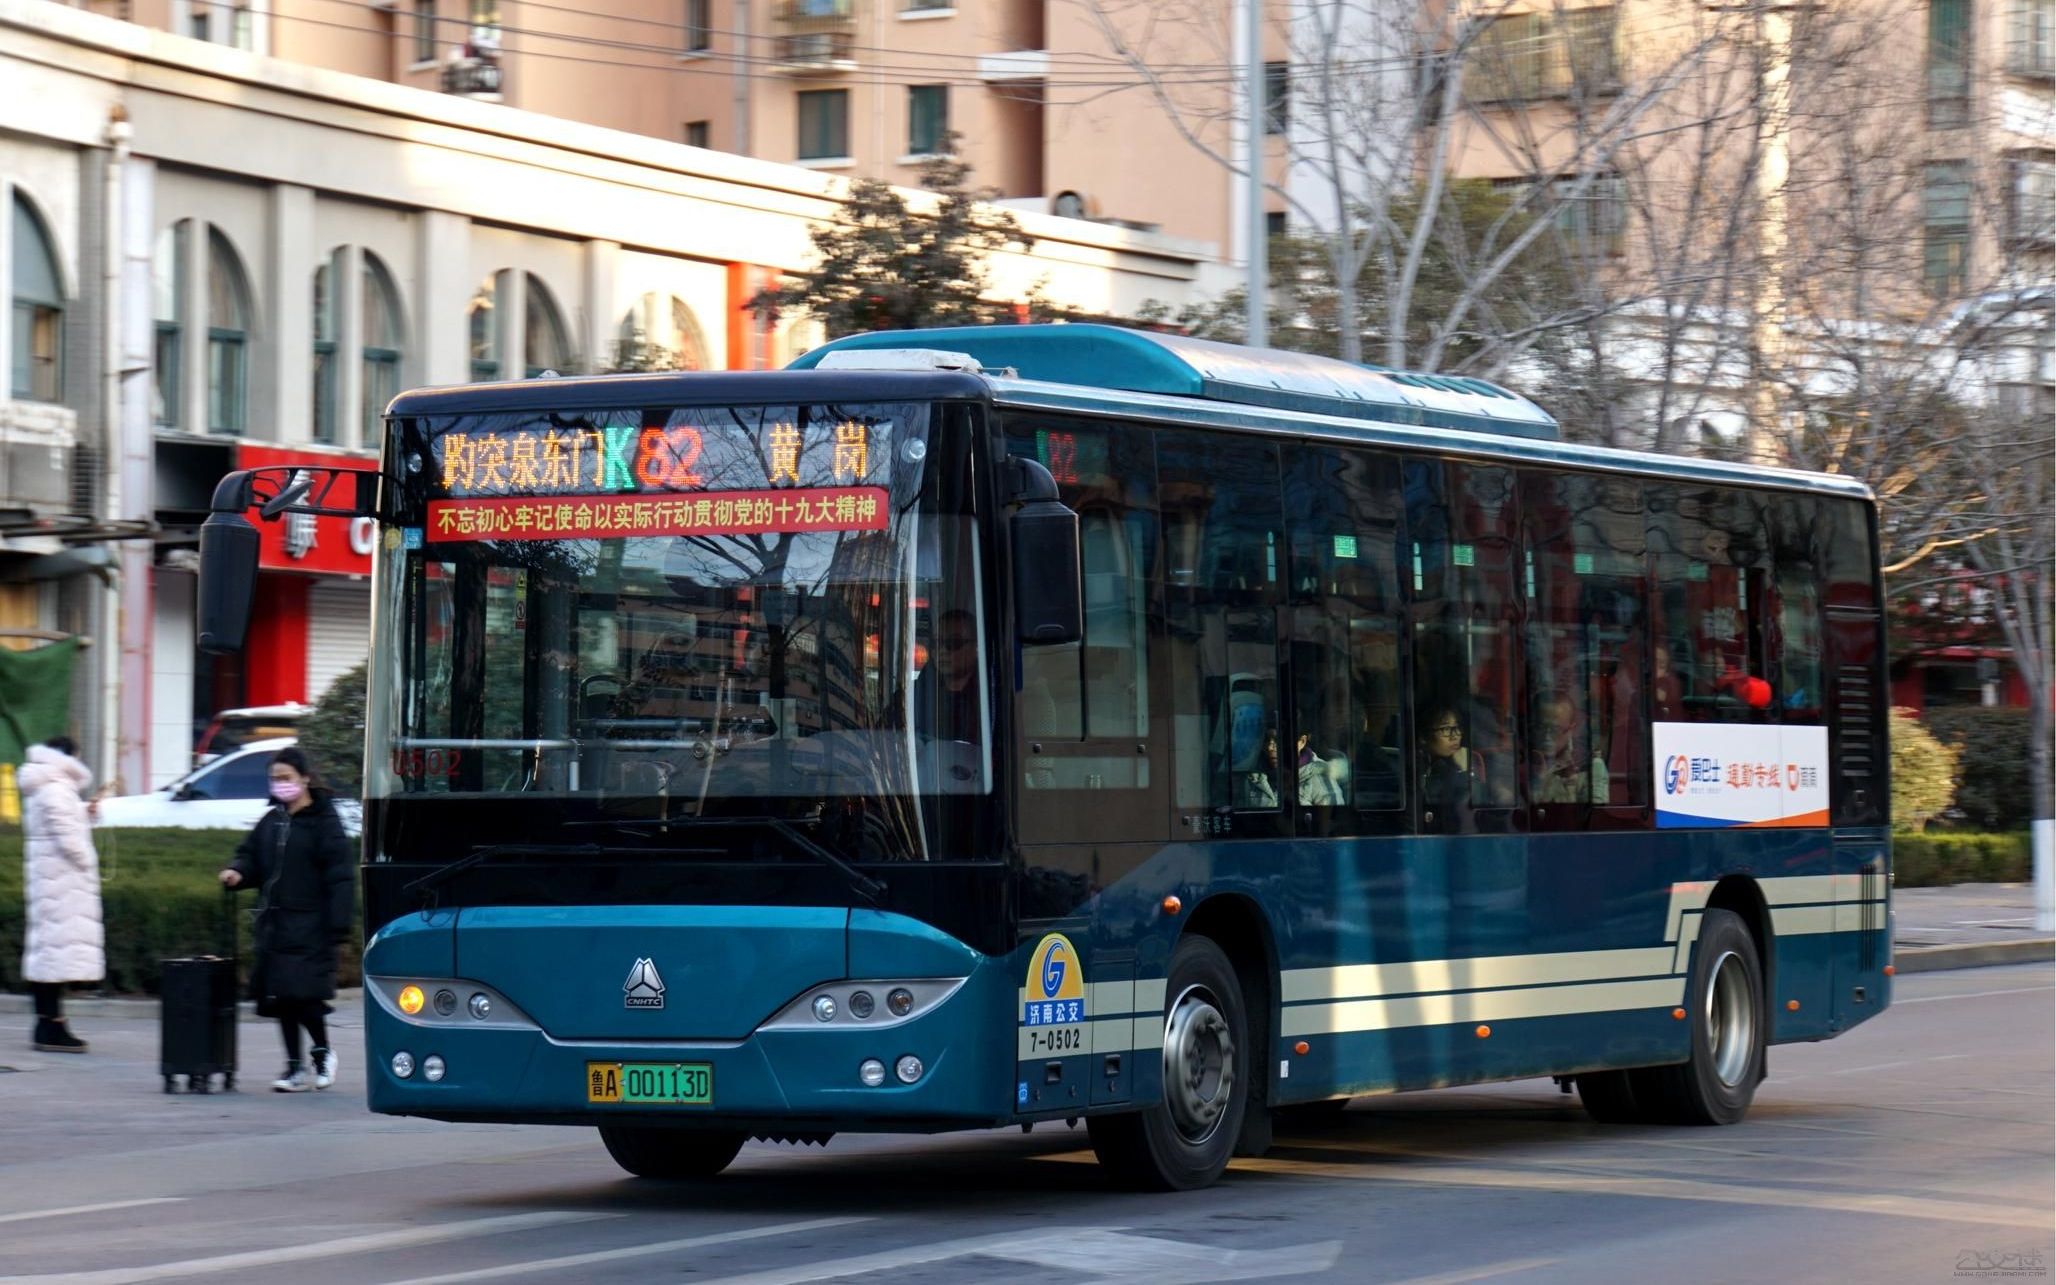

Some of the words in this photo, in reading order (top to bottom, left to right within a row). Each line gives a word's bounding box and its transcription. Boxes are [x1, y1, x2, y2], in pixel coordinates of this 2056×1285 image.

[443, 428, 602, 489] 趵突泉东门
[604, 426, 703, 488] K82
[437, 494, 876, 535] 不忘初心牢记使命以实际行动贯彻党的十九大精神
[393, 749, 462, 776] 0502
[1030, 1002, 1078, 1025] 济南公交
[1031, 1029, 1080, 1052] 7-0502
[629, 1070, 708, 1098] 00113D
